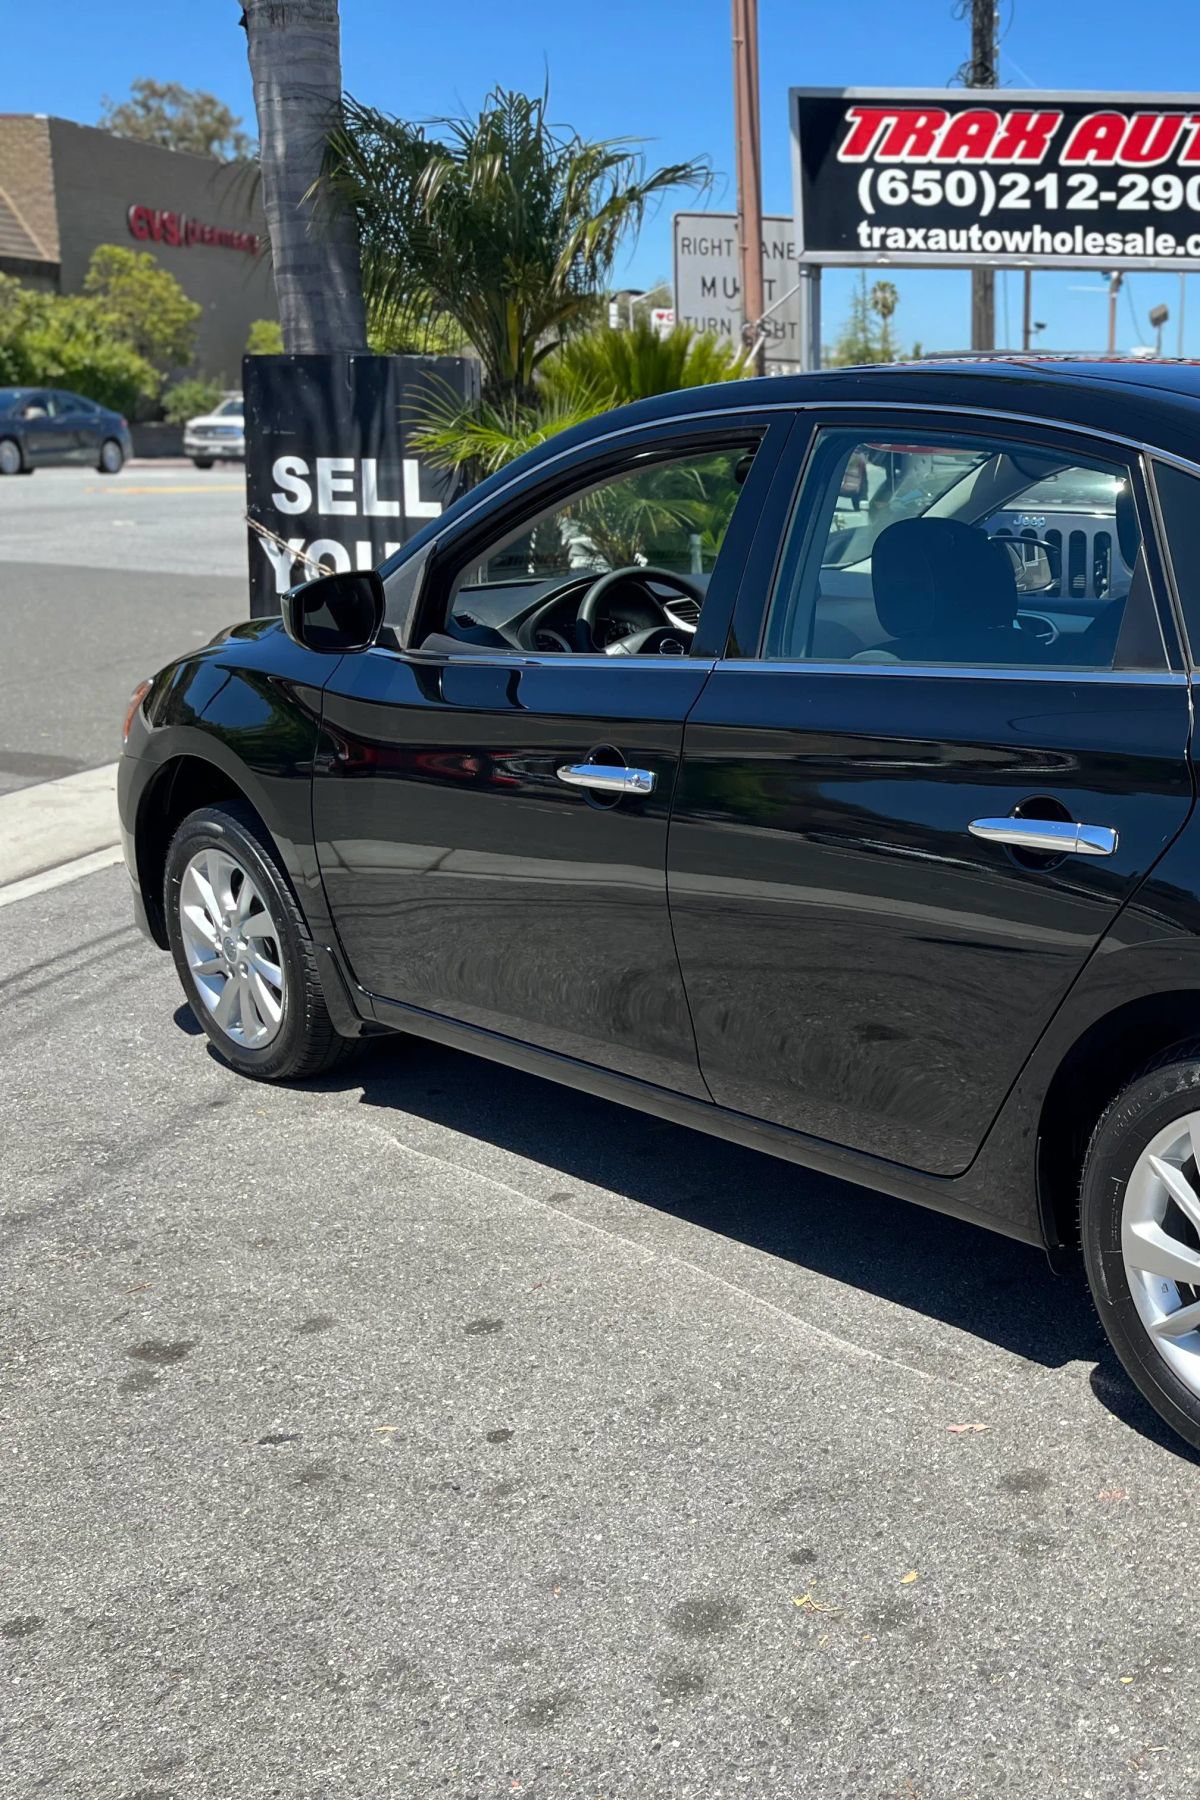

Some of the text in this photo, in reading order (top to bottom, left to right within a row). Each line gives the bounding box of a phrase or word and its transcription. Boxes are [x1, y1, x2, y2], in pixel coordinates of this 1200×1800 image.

[836, 106, 1064, 164] TRAX
[129, 204, 182, 247] CVS
[681, 237, 796, 260] RIGHT ANE
[701, 276, 777, 301] MUT
[684, 316, 732, 335] TURN
[271, 455, 442, 518] SELL
[1013, 514, 1046, 527] Jeep
